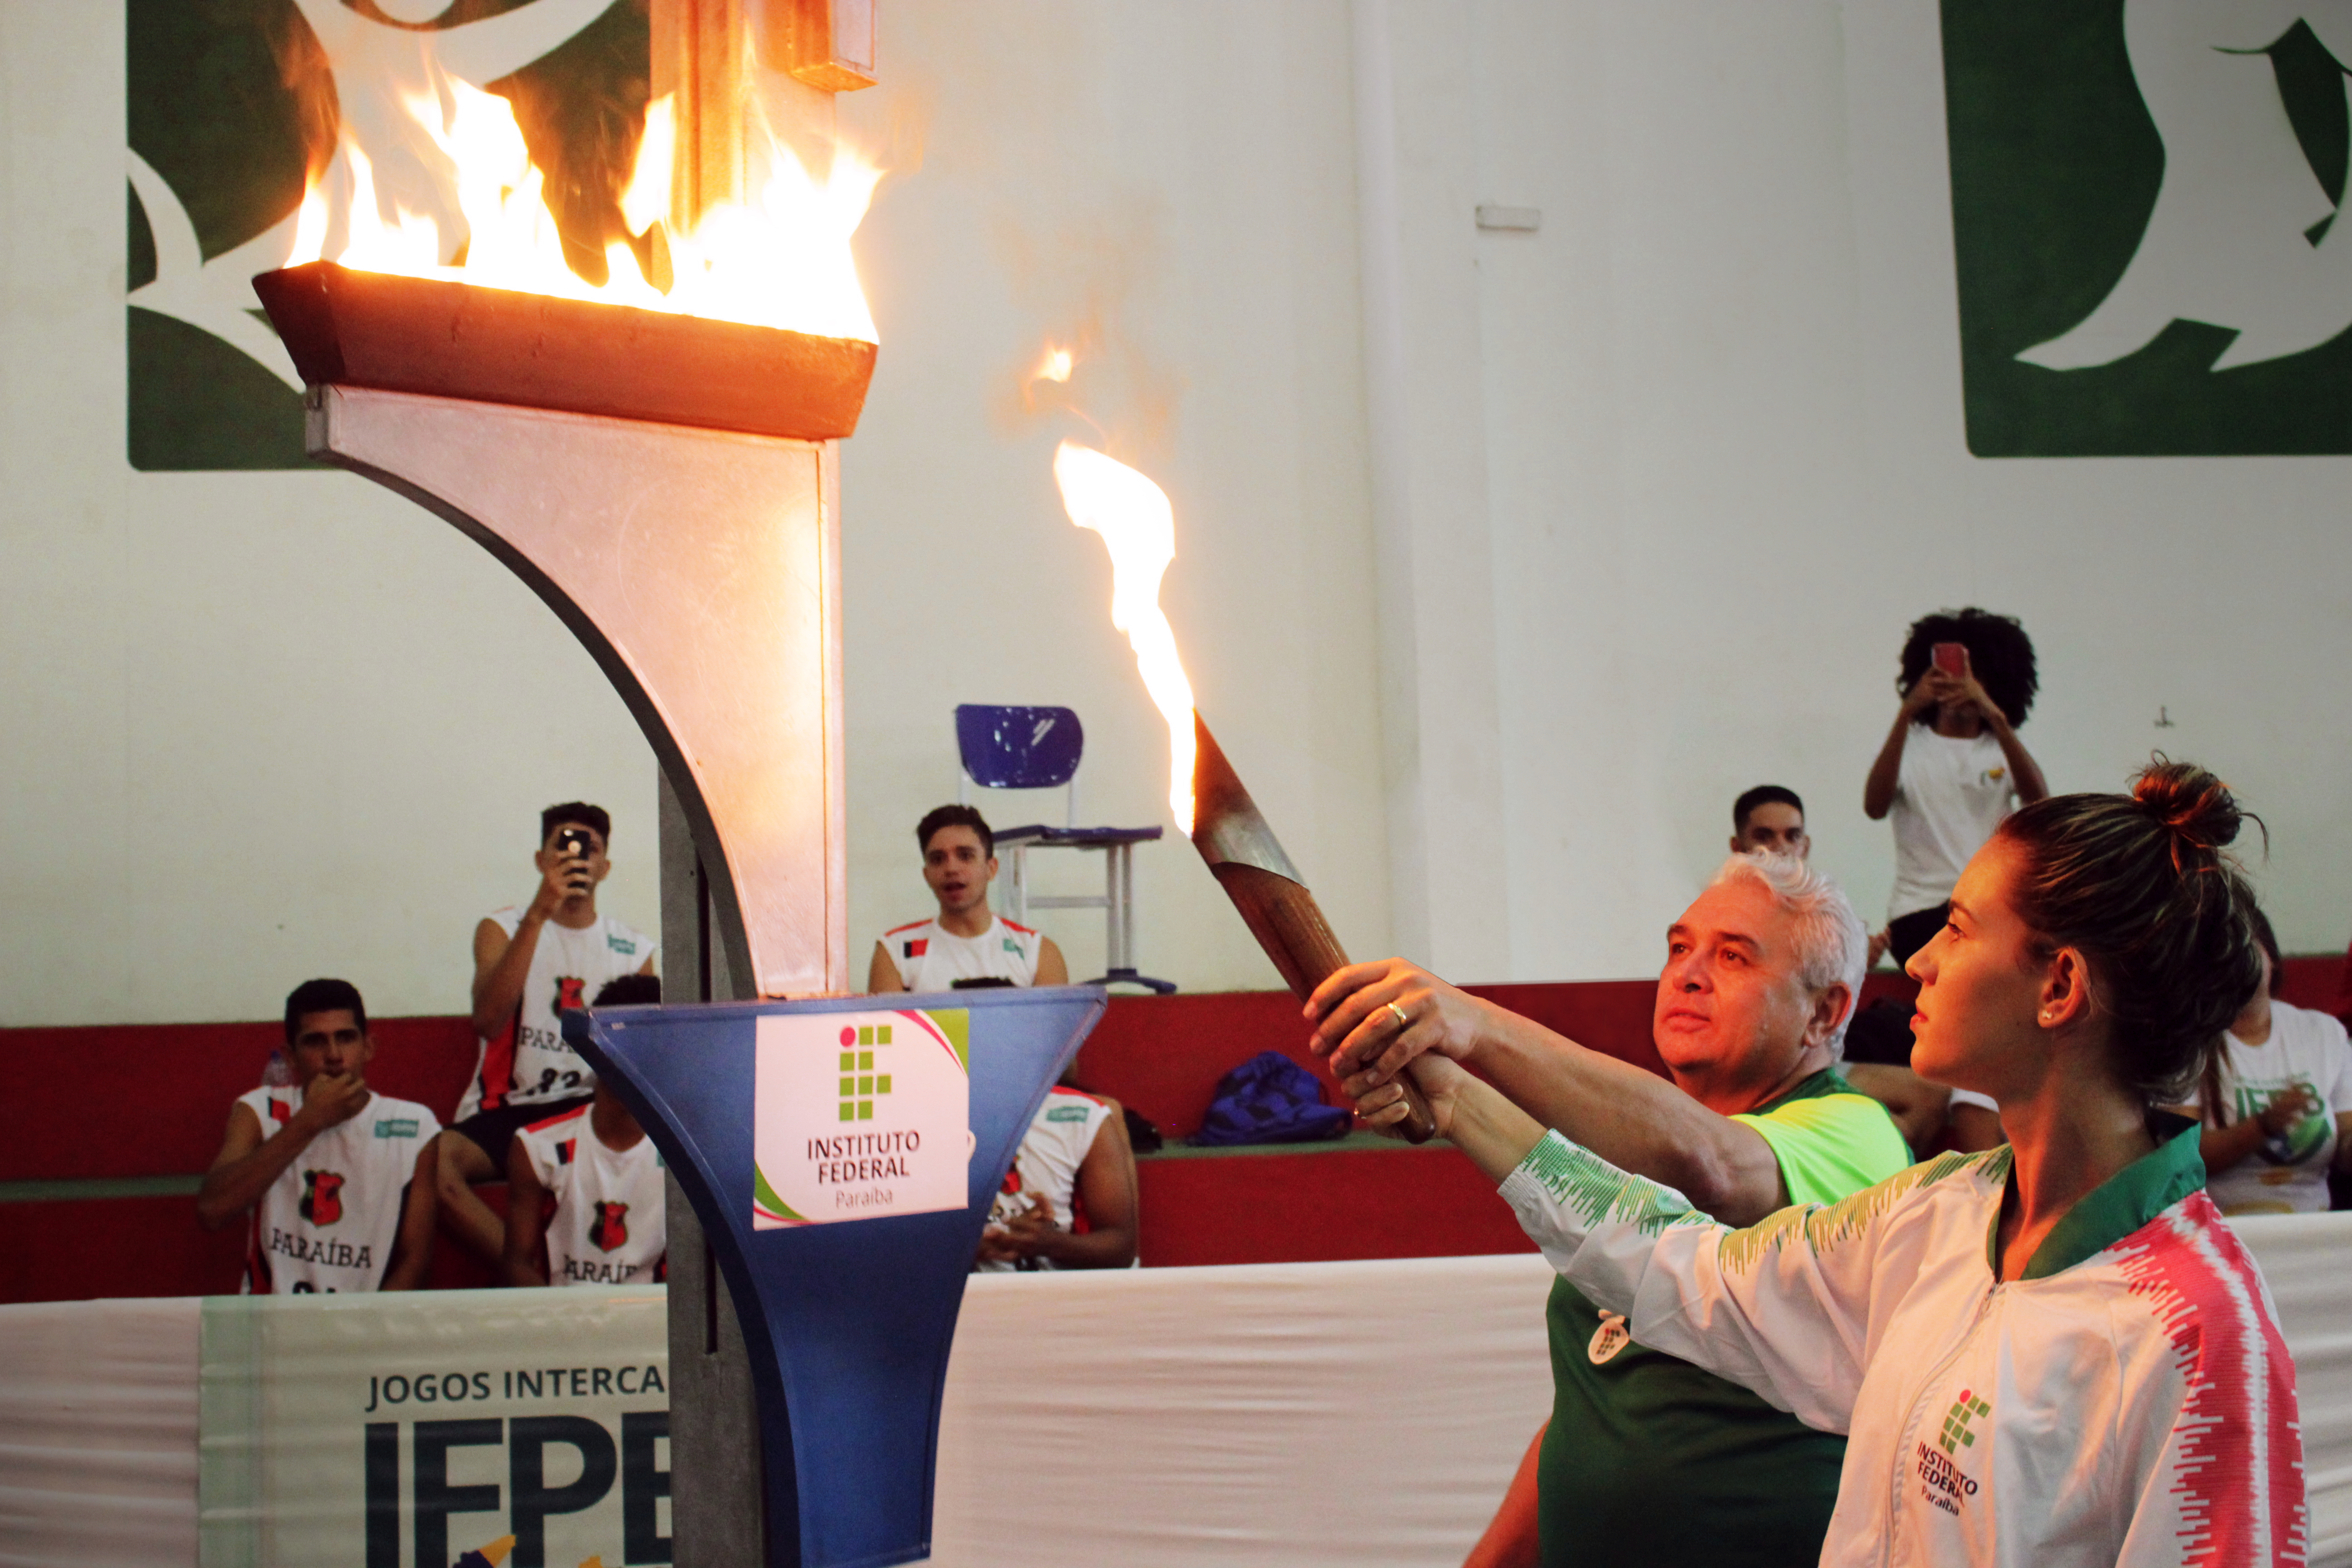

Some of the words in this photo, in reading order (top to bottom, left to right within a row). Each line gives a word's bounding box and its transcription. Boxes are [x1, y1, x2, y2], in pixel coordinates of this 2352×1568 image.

[808, 1130, 920, 1160] INSTITUTO
[818, 1156, 910, 1185] FEDERAL
[272, 1227, 372, 1268] PARAÍBA
[365, 1372, 490, 1412] JOGOS
[504, 1365, 665, 1399] INTERCA
[1917, 1441, 1978, 1496] INSTITUTO
[1917, 1460, 1965, 1508] FEDERAL
